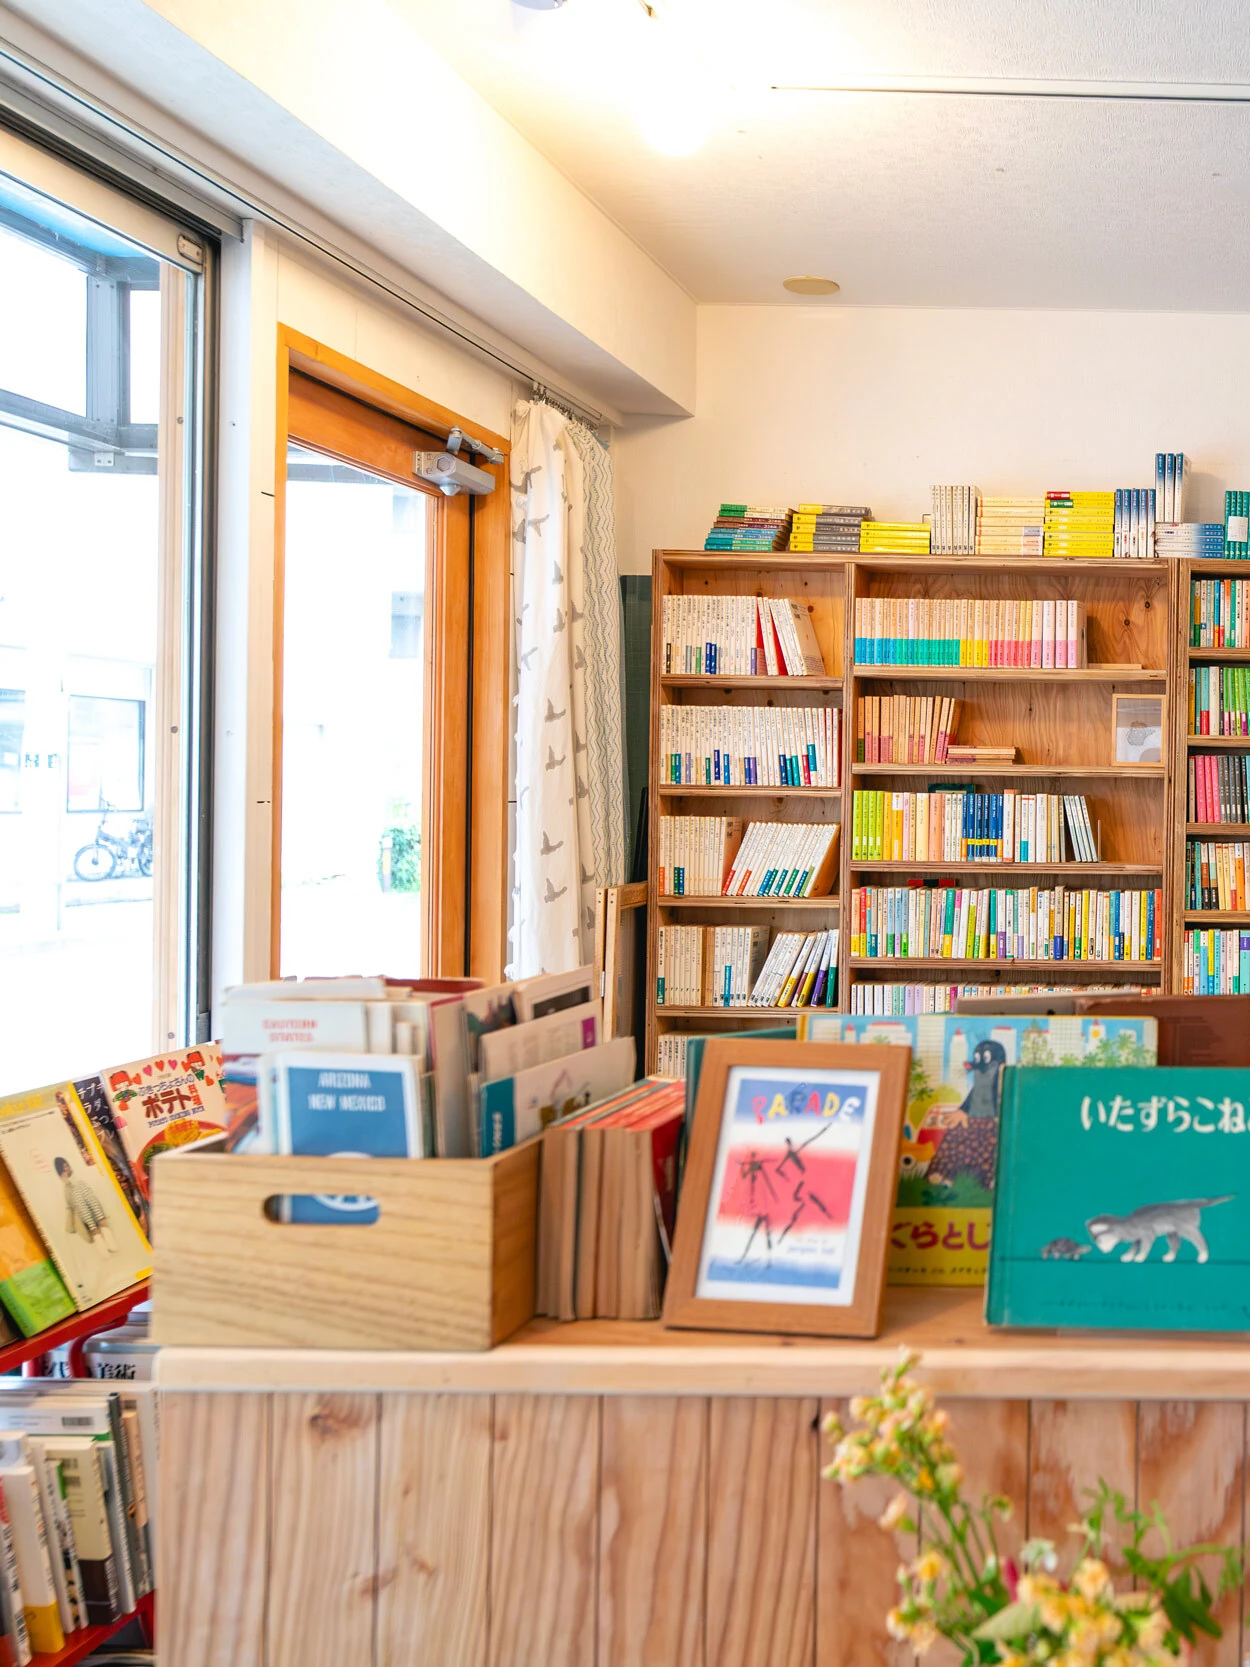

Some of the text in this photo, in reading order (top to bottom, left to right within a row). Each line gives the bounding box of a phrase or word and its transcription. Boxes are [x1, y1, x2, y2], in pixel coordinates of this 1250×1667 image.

[317, 1071, 372, 1089] ARIZONA
[307, 1093, 386, 1112] NEW MEXICO
[751, 1090, 862, 1126] PARADE
